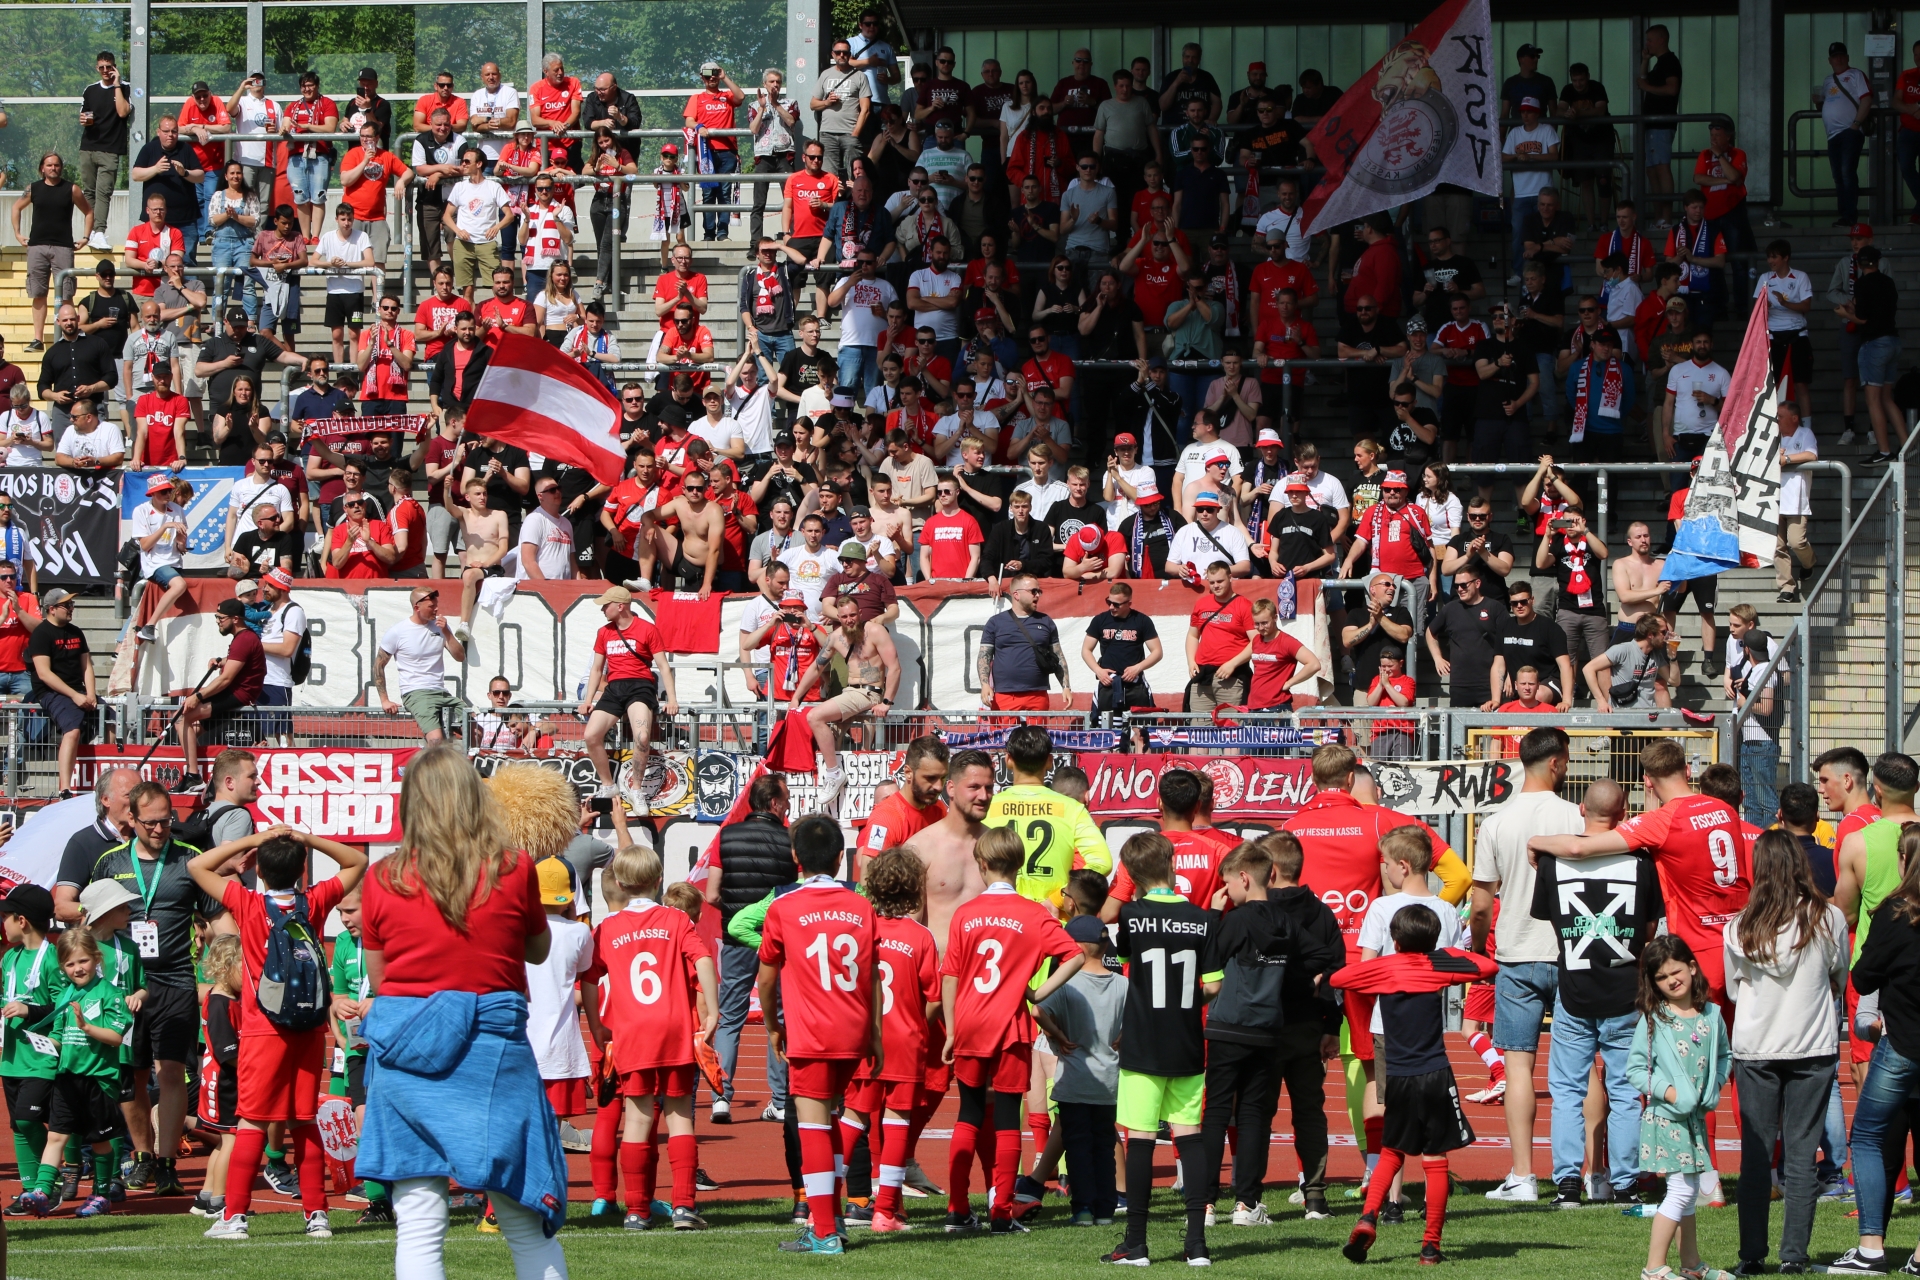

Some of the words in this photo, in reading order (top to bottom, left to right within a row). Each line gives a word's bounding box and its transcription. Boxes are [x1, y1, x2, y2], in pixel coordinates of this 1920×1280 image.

[255, 752, 404, 794] KASSEL
[1427, 761, 1513, 809] RWB
[256, 794, 395, 837] SQUAD
[1002, 800, 1054, 816] GRÖTEKE
[1689, 809, 1732, 831] FISCHER
[1306, 827, 1335, 837] HESSEN
[1336, 826, 1364, 836] KASSEL
[1707, 829, 1739, 888] 9
[612, 933, 632, 949] SVH
[632, 927, 671, 941] KASSEL
[799, 912, 822, 927] SVH
[823, 910, 863, 928] KASSEL
[963, 917, 983, 932] SVH
[985, 915, 1024, 934] KASSEL
[1128, 918, 1157, 933] SVH
[1161, 917, 1208, 937] Kassel
[629, 950, 663, 1005] 6
[805, 932, 859, 993] 13
[973, 938, 1004, 995] 3
[1140, 947, 1197, 1009] 11
